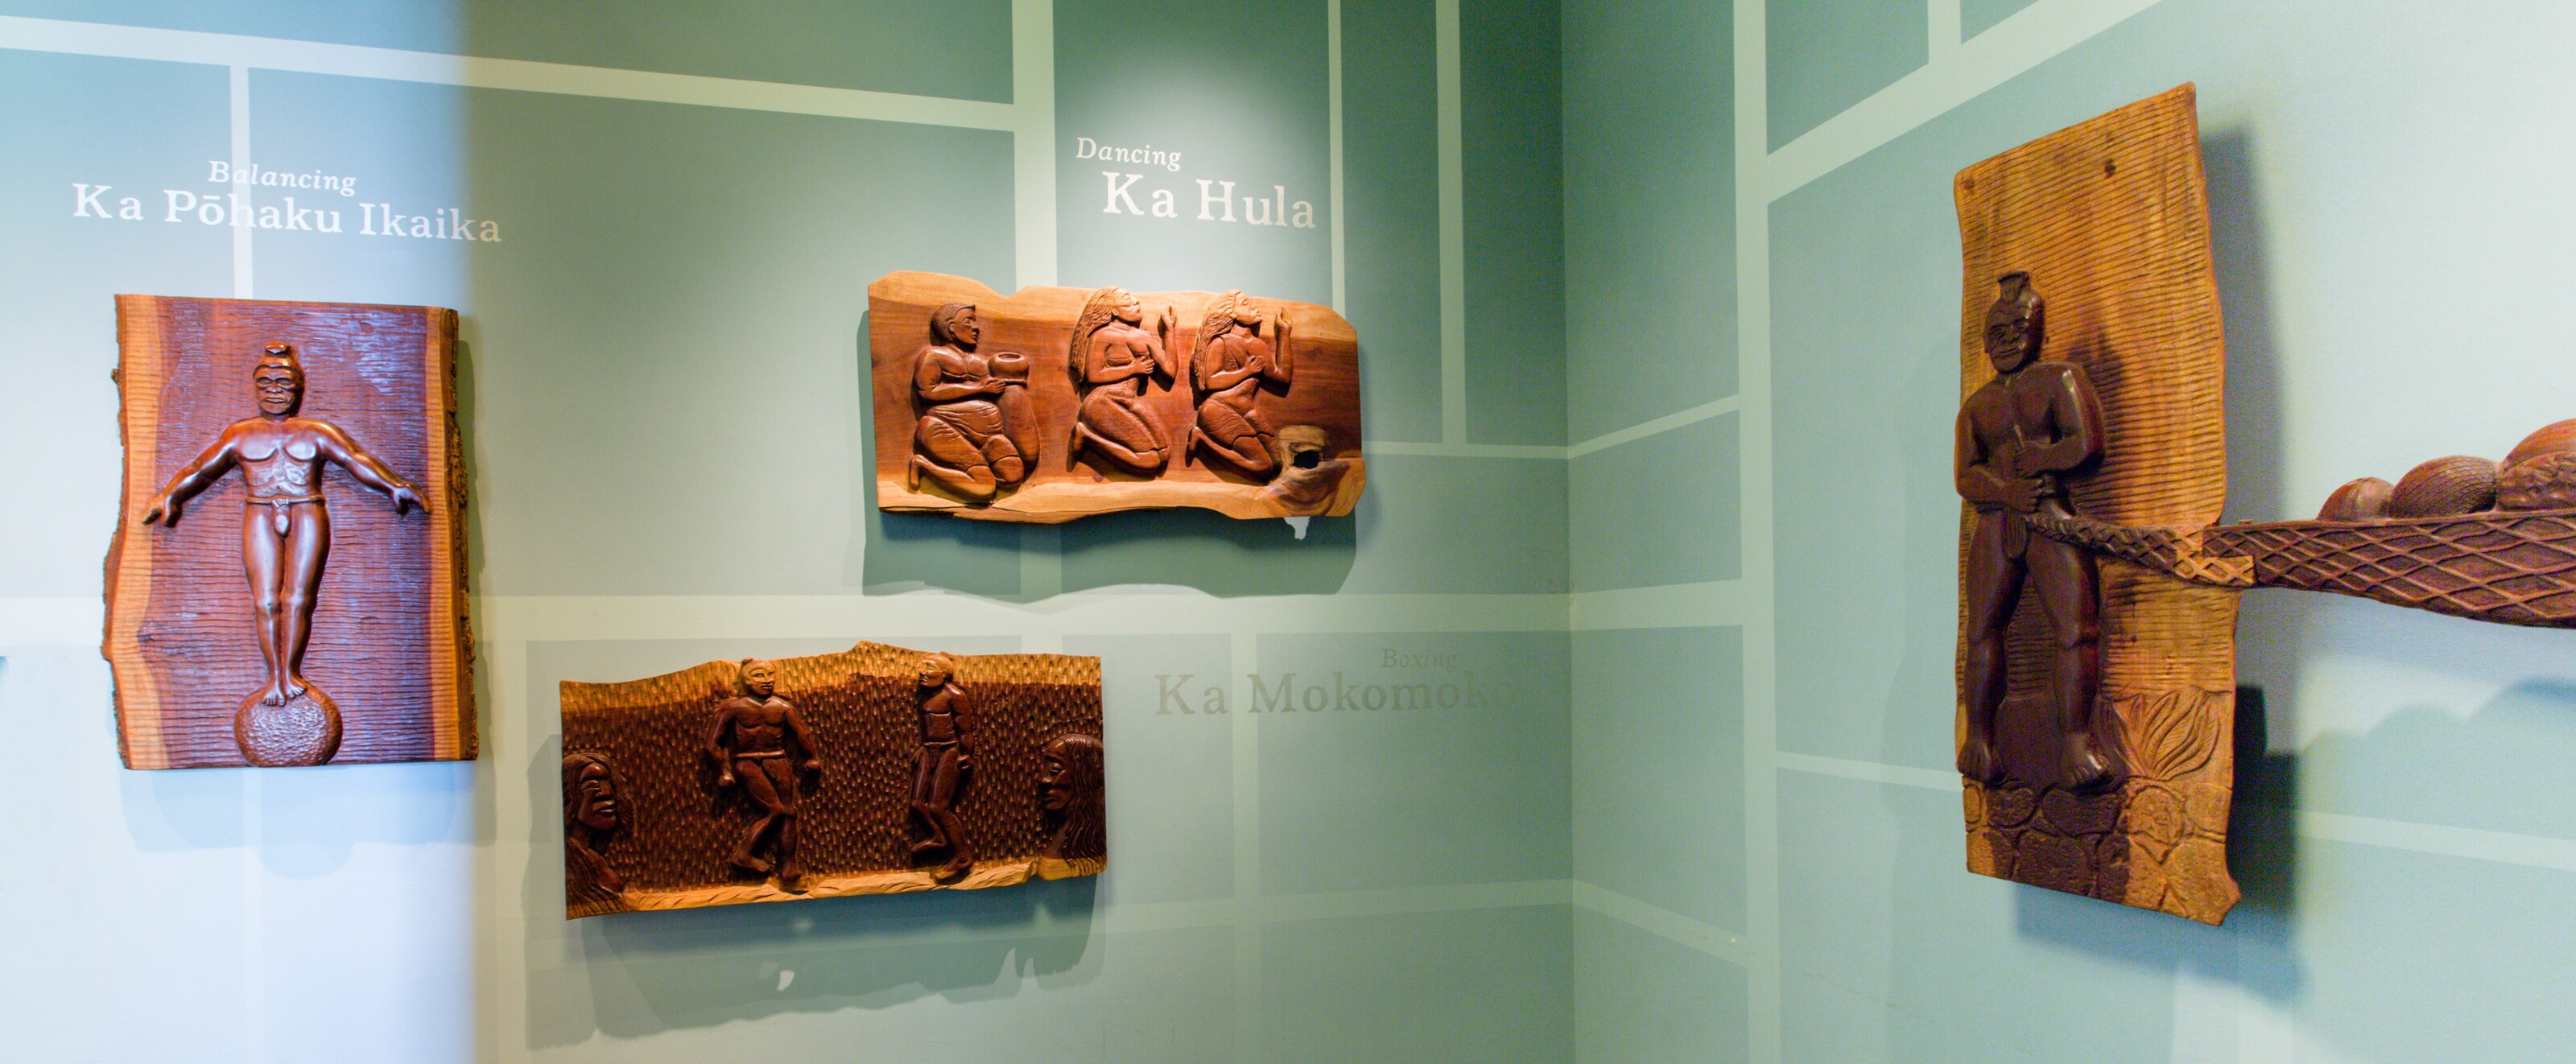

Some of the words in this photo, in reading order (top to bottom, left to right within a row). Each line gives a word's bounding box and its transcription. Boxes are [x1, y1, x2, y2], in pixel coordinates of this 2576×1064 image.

[1075, 137, 1182, 171] Dancing
[207, 160, 357, 196] Balancing
[72, 183, 144, 221] Ka
[163, 188, 342, 233] Pōhaku
[359, 202, 502, 242] Ikaika
[1101, 170, 1178, 218] Ka
[1195, 179, 1317, 229] Hula
[1381, 647, 1459, 673] Boxing
[1154, 674, 1229, 716] Ka
[1246, 669, 1518, 714] Mokomoko
